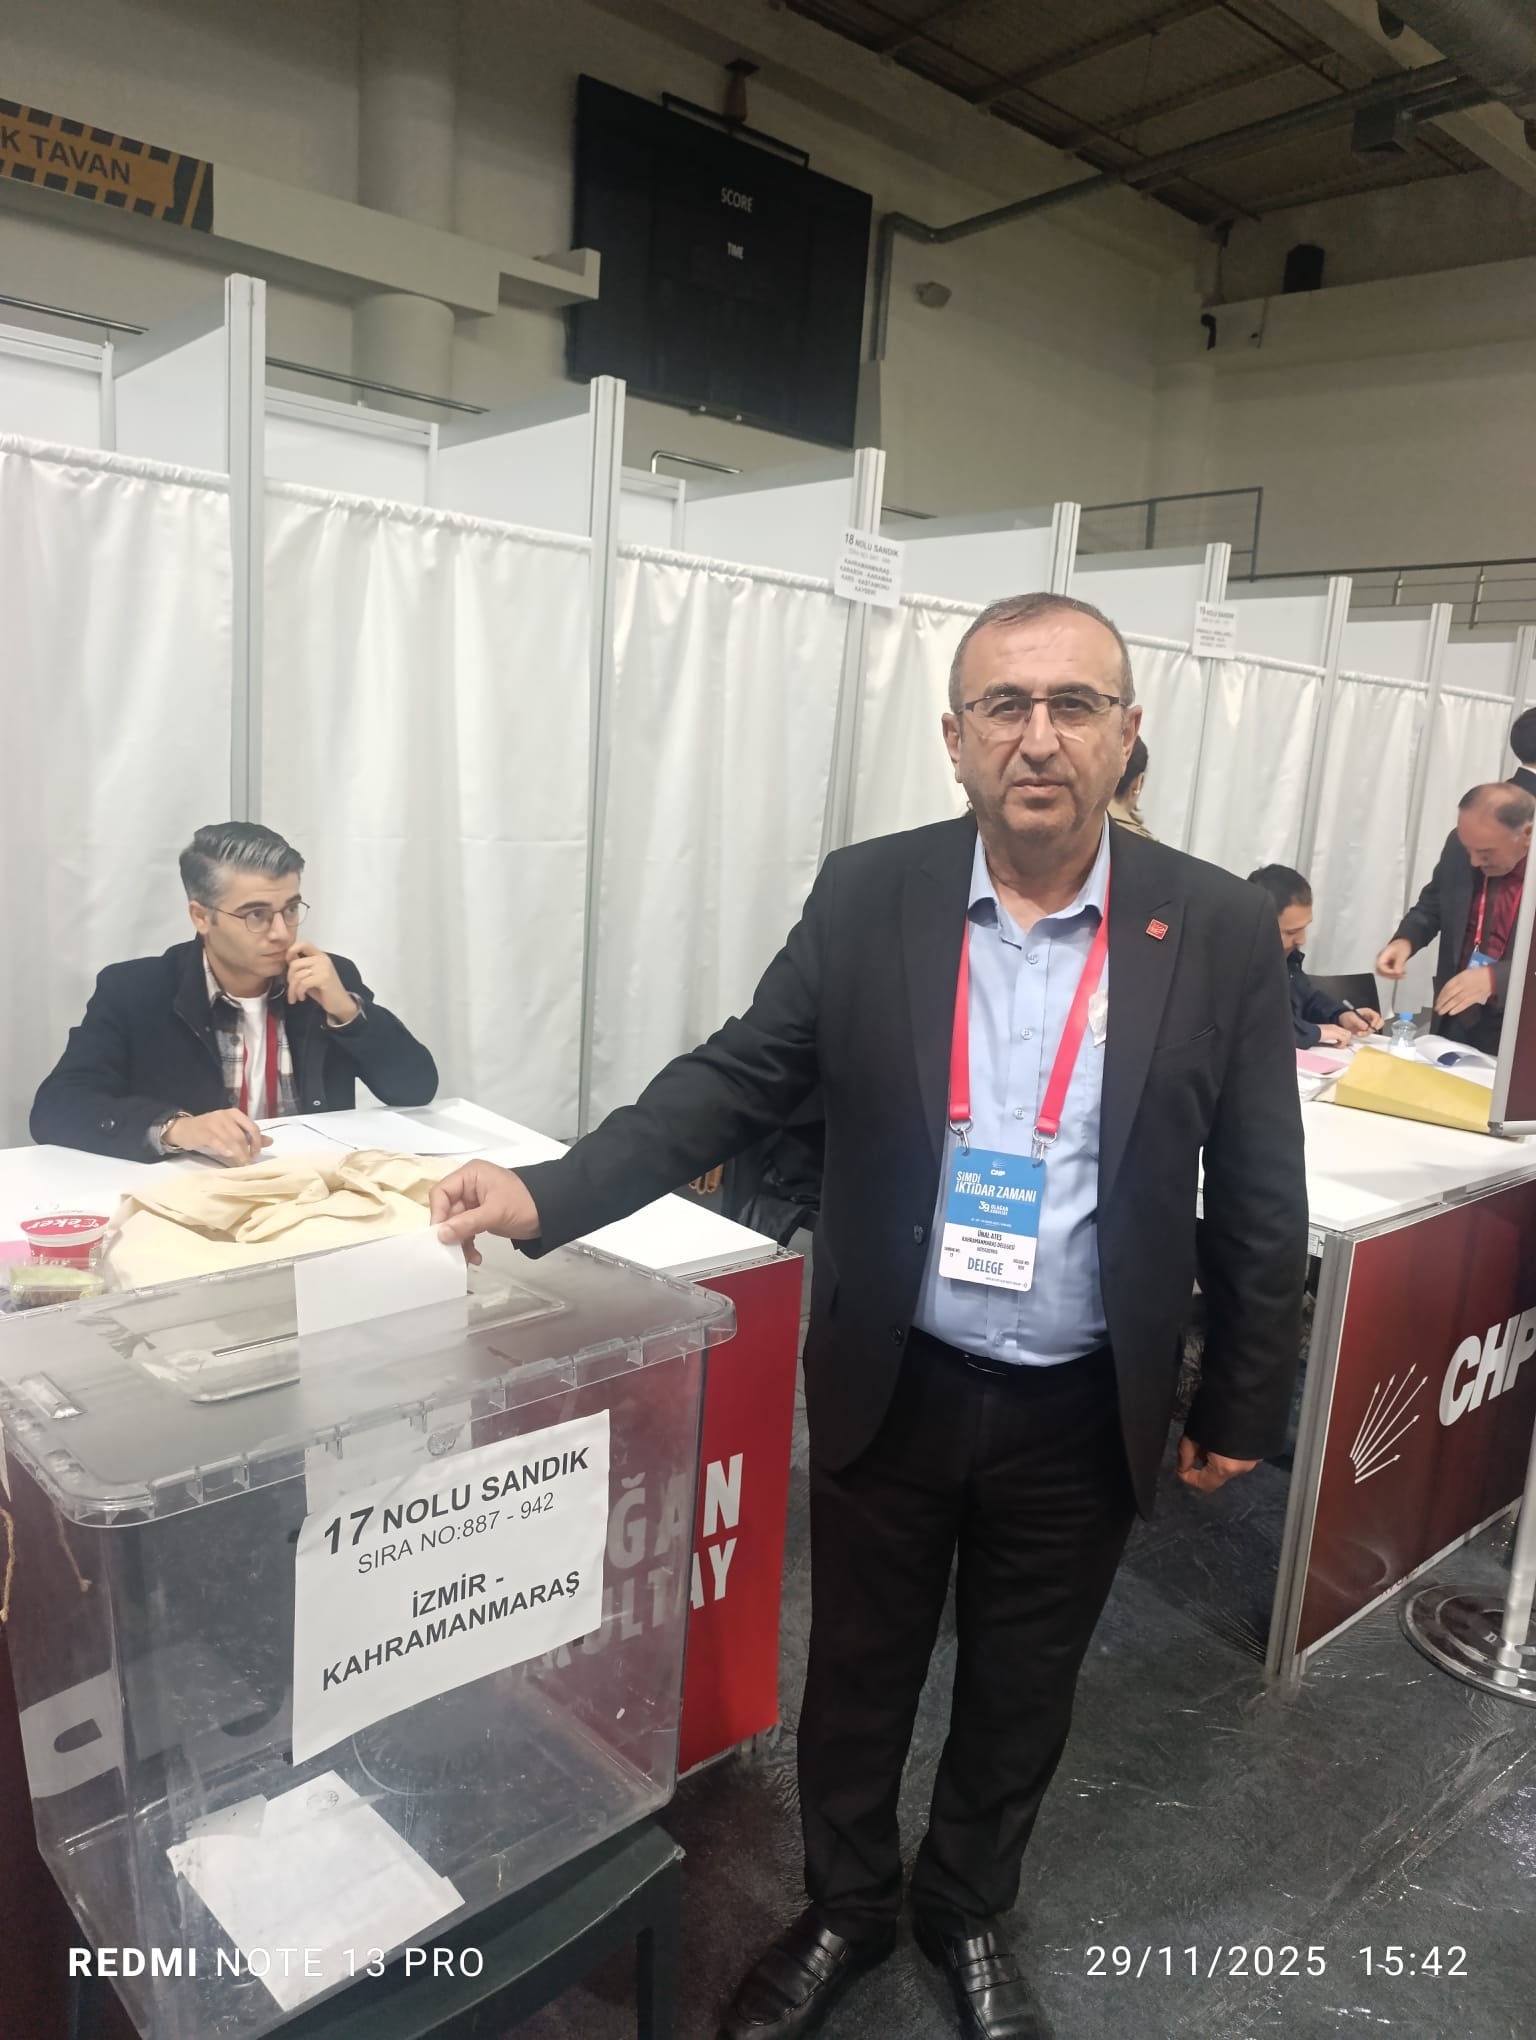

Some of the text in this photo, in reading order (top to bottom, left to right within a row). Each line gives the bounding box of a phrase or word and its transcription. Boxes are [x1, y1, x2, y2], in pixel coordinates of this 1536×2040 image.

[29, 134, 131, 184] TAVAN
[721, 187, 753, 213] SCORE
[845, 533, 854, 545] 18
[874, 545, 899, 557] SANDIK
[955, 1182, 1037, 1203] İKTİDAR ZAMANI
[968, 1256, 1004, 1275] DELEGE
[1439, 1306, 1536, 1427] CHP
[324, 1447, 589, 1555] 17 NOLU SANDIK
[357, 1538, 414, 1574] SIRA
[420, 1512, 499, 1550] NO:887
[520, 1492, 554, 1520] 942
[411, 1573, 487, 1617] İZMİR
[323, 1571, 581, 1691] KAHRAMANMARAŞ
